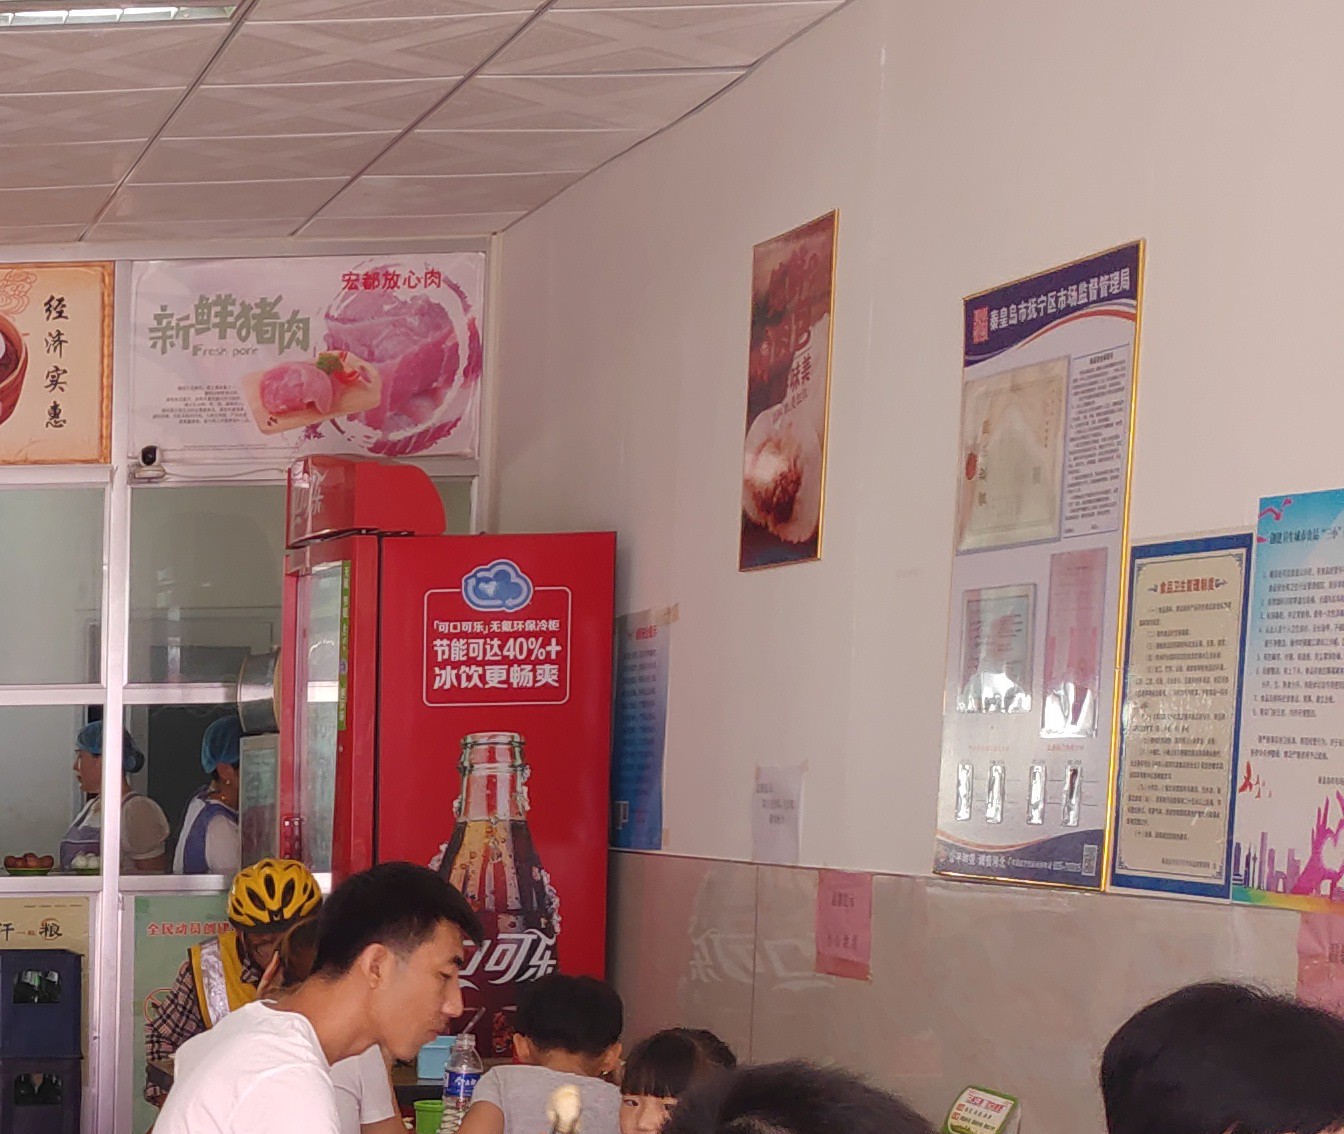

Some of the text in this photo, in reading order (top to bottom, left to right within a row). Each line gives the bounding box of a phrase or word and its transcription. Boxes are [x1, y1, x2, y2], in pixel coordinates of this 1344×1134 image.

[342, 268, 442, 290] 宏都放心肉
[989, 267, 1130, 331] 秦皇岛市抚宁区市场监督管理局
[148, 294, 310, 355] 新鲜猪肉
[43, 294, 67, 431] 经济实惠
[193, 344, 258, 357] Fresh pork
[433, 637, 561, 662] 节能可达40%+
[433, 664, 560, 690] 冰饮更畅爽
[147, 922, 234, 936] 全民动员创建
[458, 928, 557, 991] 口可乐
